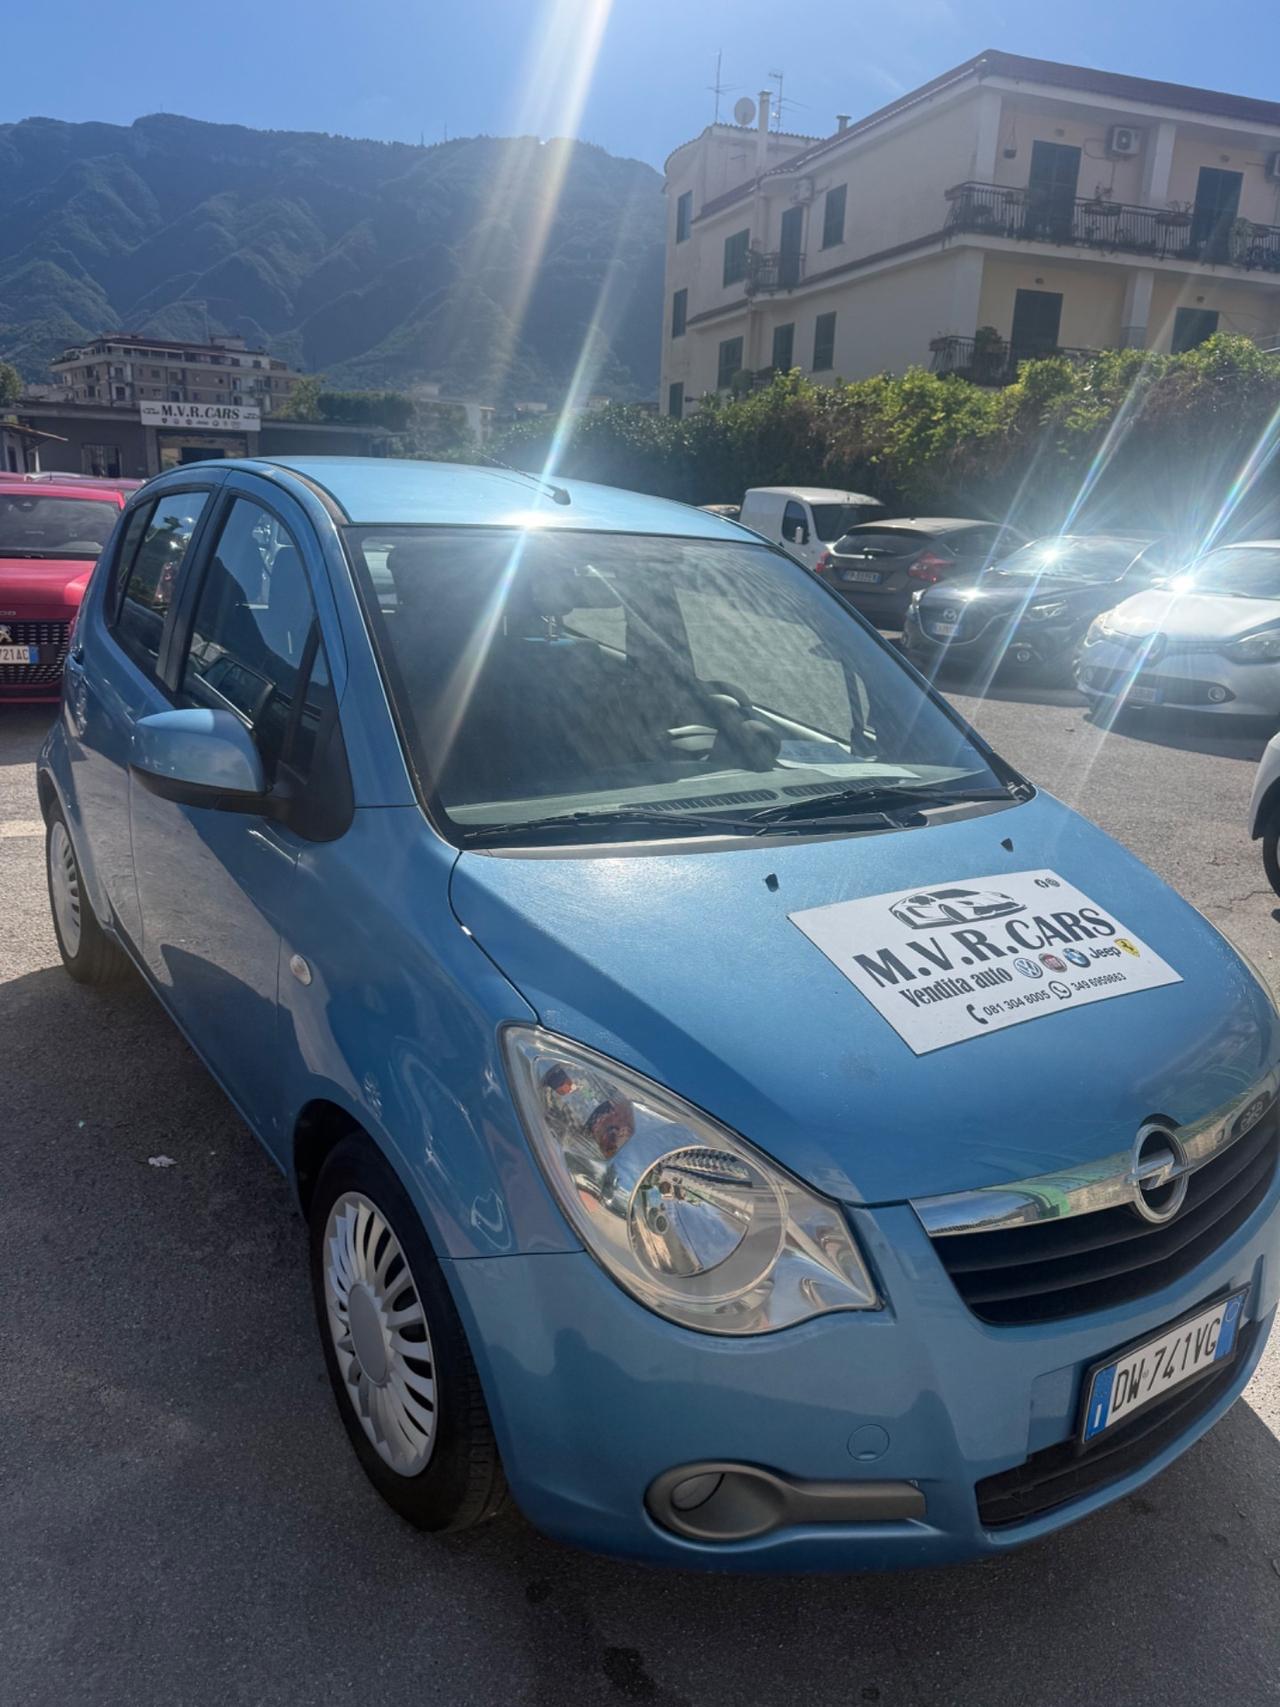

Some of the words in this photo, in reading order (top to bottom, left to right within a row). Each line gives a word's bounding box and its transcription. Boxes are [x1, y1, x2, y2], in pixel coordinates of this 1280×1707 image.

[161, 404, 240, 420] M.V.R.CARS
[852, 907, 1117, 989] M.V.R.CARS
[898, 977, 976, 1008] Vendita
[970, 966, 1013, 989] auto
[1088, 946, 1122, 959] Jeep
[1070, 980, 1091, 992] 349
[982, 1003, 1006, 1017] 081
[1003, 997, 1026, 1011] 304
[1024, 990, 1051, 1005] 8005
